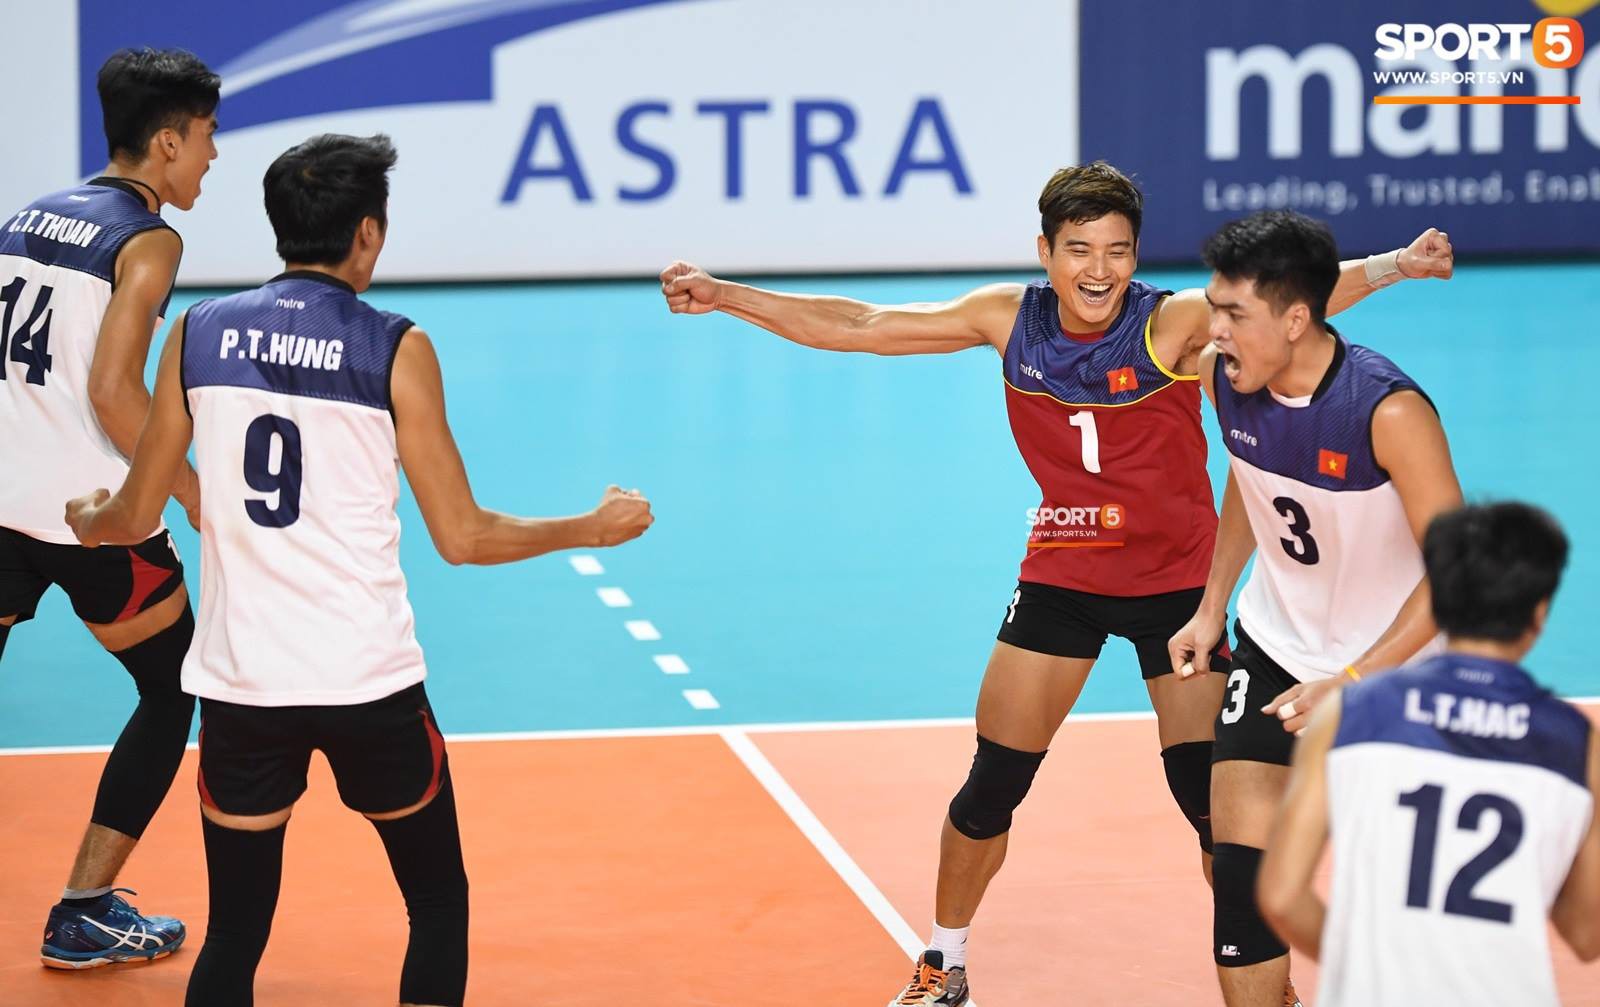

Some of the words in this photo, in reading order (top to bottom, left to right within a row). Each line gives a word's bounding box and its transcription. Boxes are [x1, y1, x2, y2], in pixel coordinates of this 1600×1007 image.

[499, 97, 975, 204] ASTRA
[0, 276, 54, 386] 14
[276, 298, 305, 310] mitre
[220, 328, 344, 371] P.T.HUNG
[243, 413, 302, 528] 9
[1069, 410, 1101, 473] 1
[1273, 496, 1320, 565] 3
[1222, 669, 1250, 725] 3
[1398, 783, 1524, 924] 12
